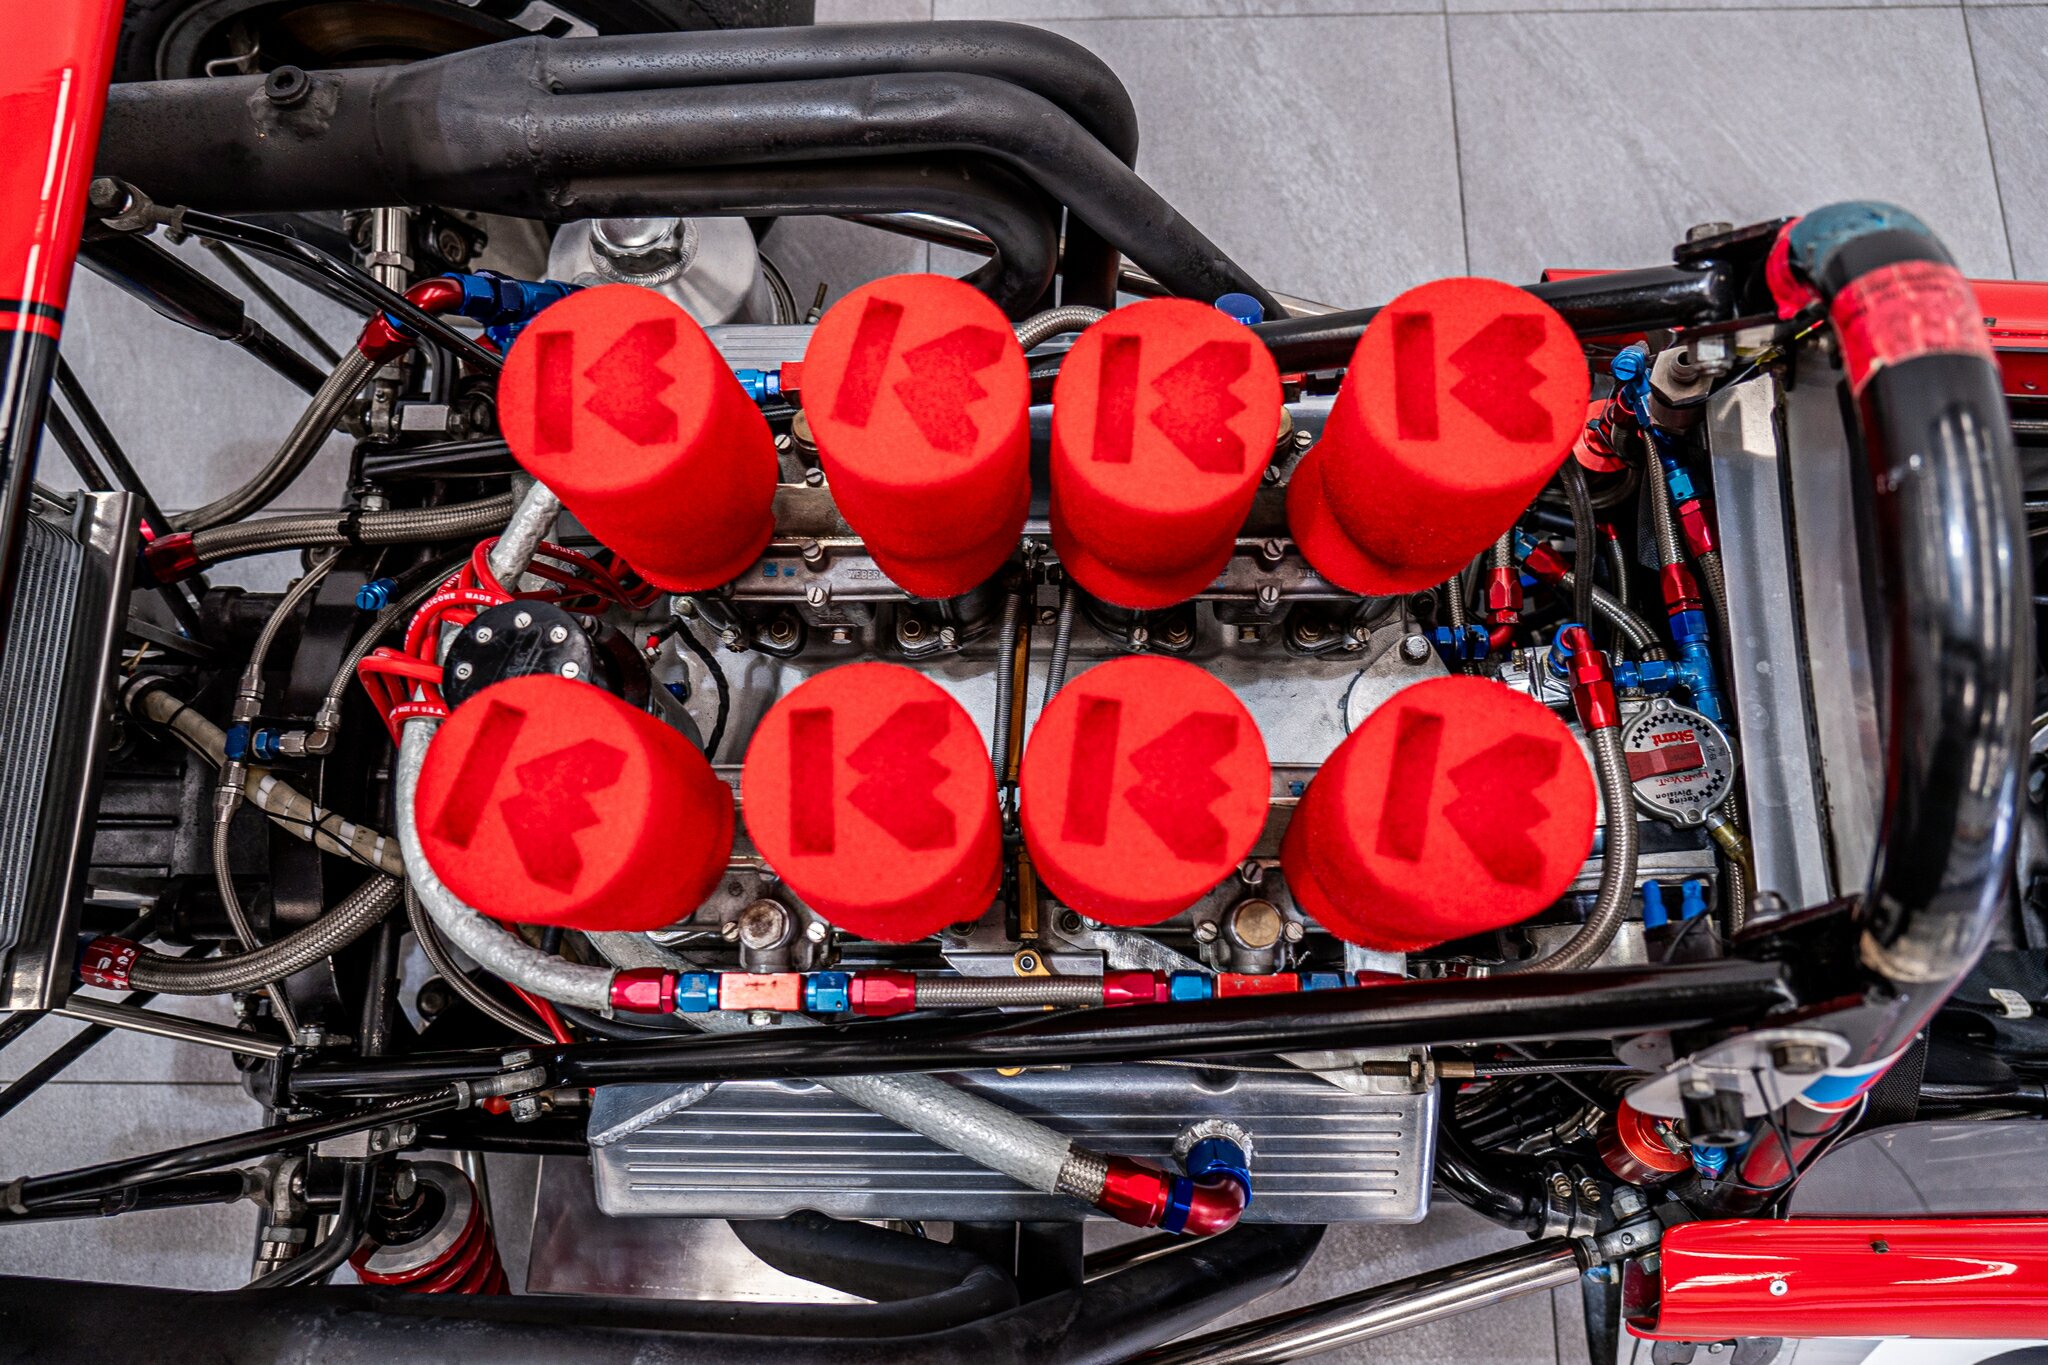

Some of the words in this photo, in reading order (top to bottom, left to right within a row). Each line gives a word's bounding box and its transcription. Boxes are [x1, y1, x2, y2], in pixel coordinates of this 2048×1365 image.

[848, 569, 880, 579] WEBER
[420, 592, 456, 613] SILICONE
[465, 592, 492, 602] MADE
[421, 706, 446, 715] U.S.A.
[1652, 730, 1695, 746] Stant
[1656, 789, 1693, 799] Division
[1669, 794, 1699, 804] Racing
